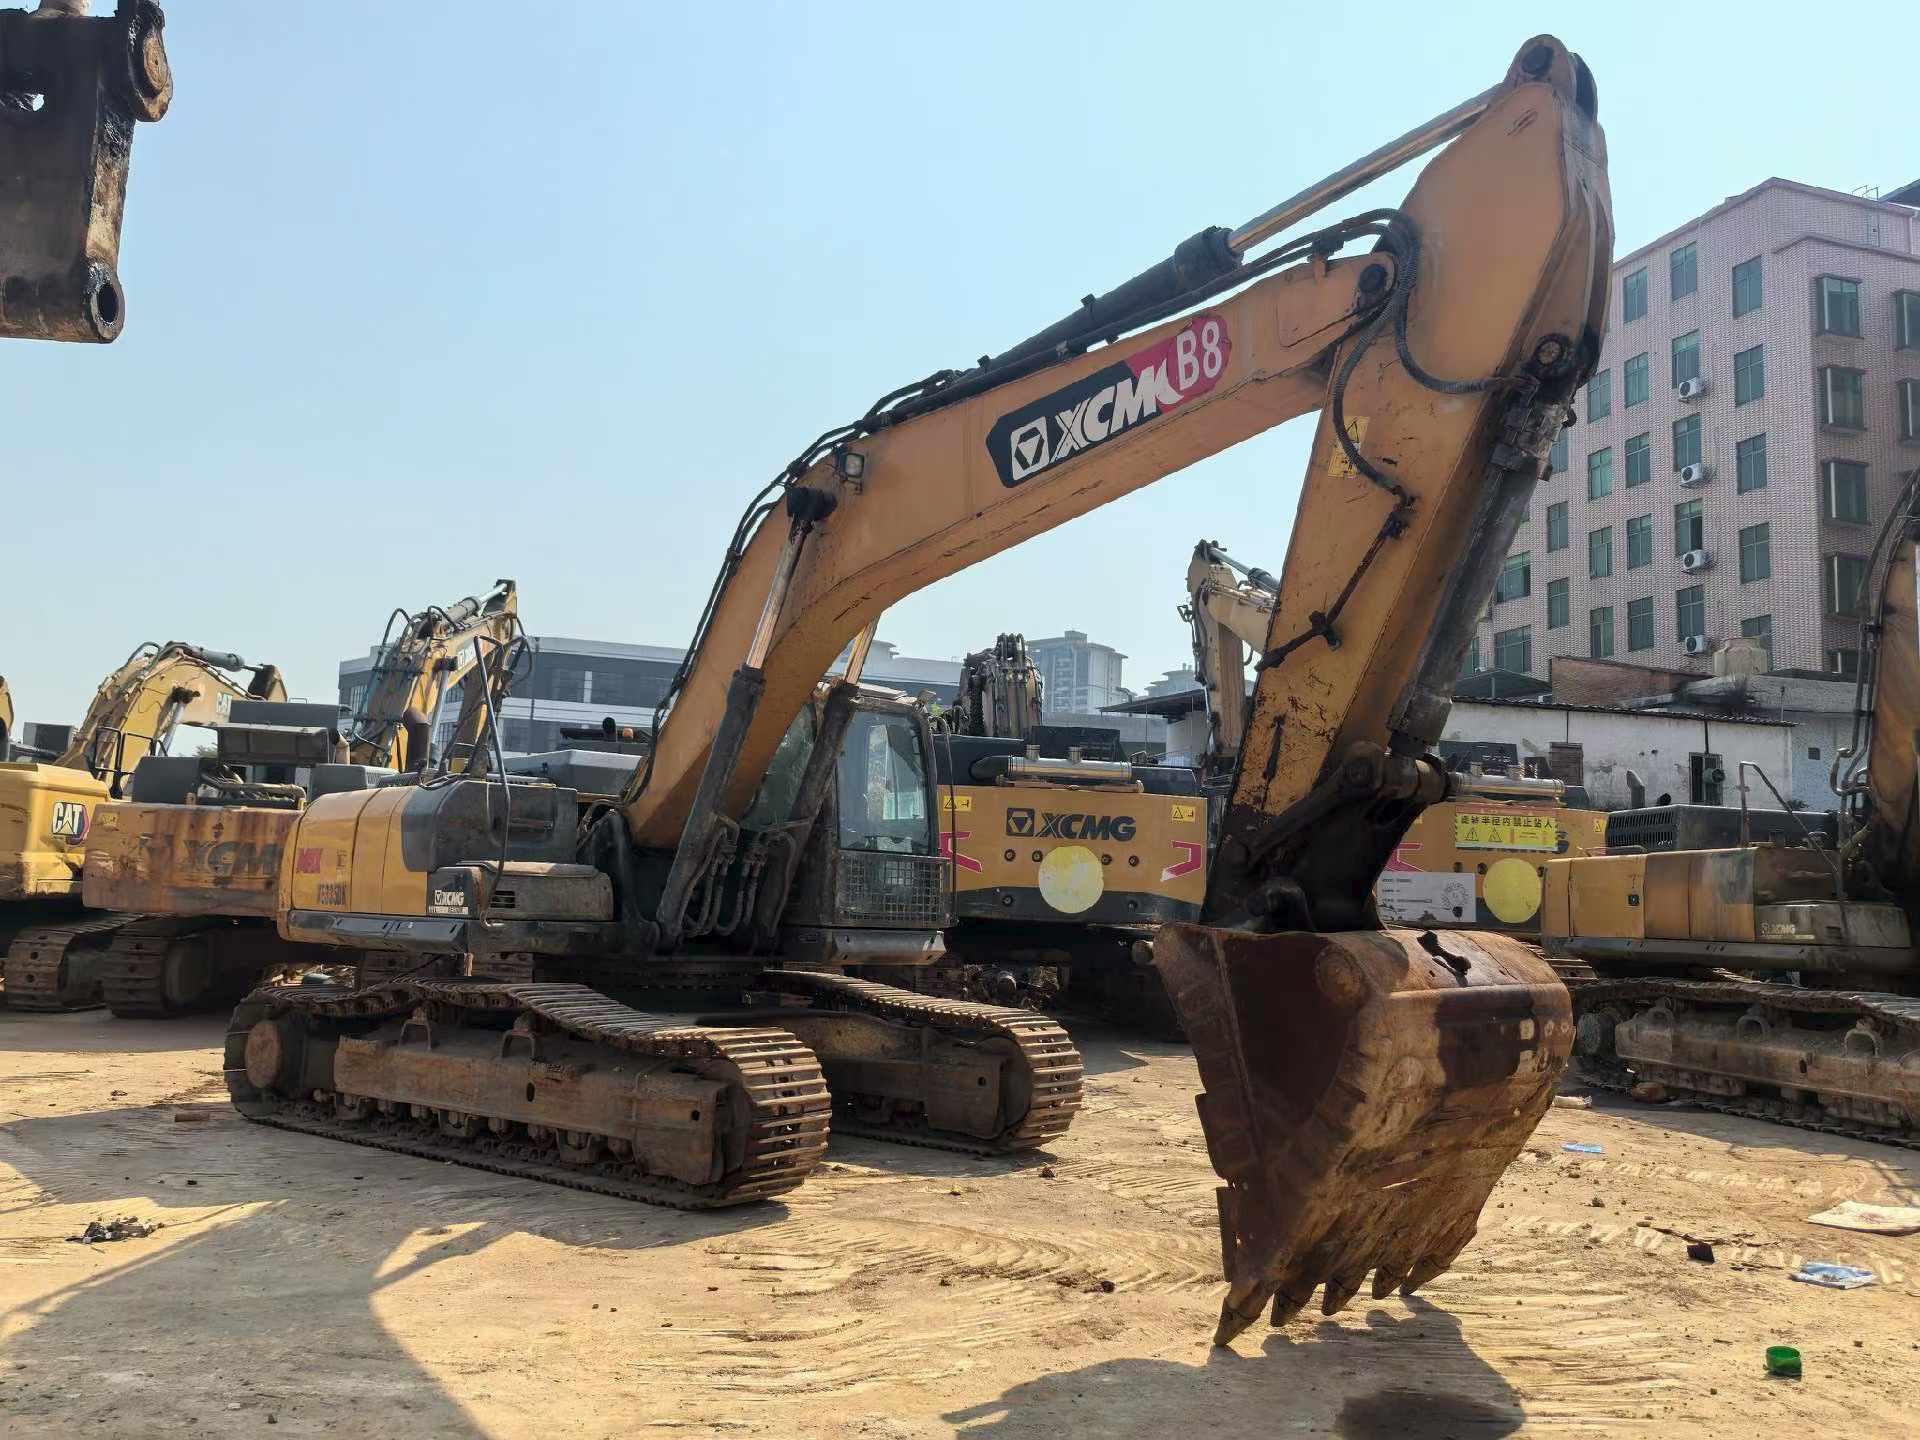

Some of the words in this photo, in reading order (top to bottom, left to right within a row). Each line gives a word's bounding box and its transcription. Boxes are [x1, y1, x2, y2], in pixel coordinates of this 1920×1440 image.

[1175, 320, 1223, 391] B8
[53, 802, 83, 835] CAT
[1034, 811, 1137, 842] XCMG
[181, 839, 283, 877] XCM
